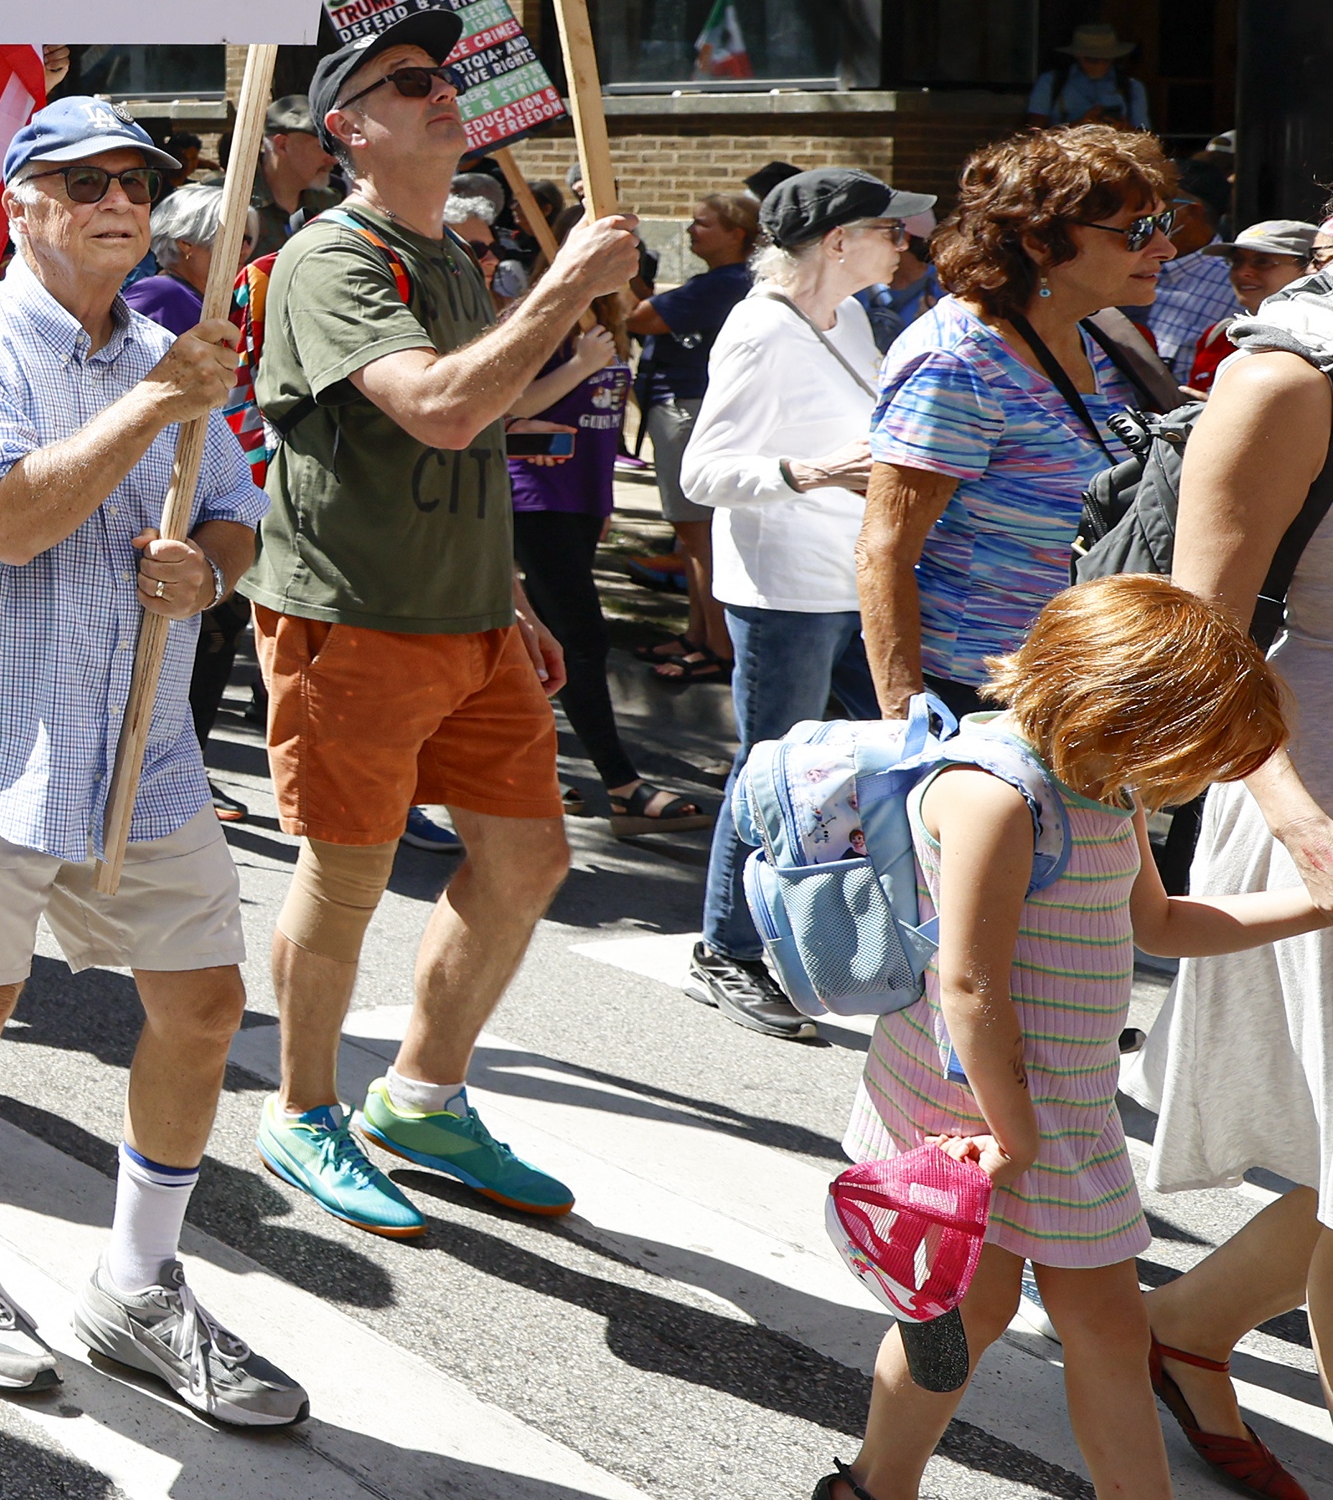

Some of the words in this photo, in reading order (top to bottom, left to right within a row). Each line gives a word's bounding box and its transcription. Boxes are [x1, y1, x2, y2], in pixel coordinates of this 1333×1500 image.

[339, 5, 408, 43] DEFEND
[474, 20, 521, 48] CRIMES
[505, 35, 530, 55] AND
[493, 48, 536, 75] RIGHTS
[500, 73, 551, 103] STRIKE
[79, 102, 122, 129] LA
[462, 92, 544, 136] EDUCATION
[497, 99, 564, 136] FREEDOM
[412, 446, 497, 520] CIT
